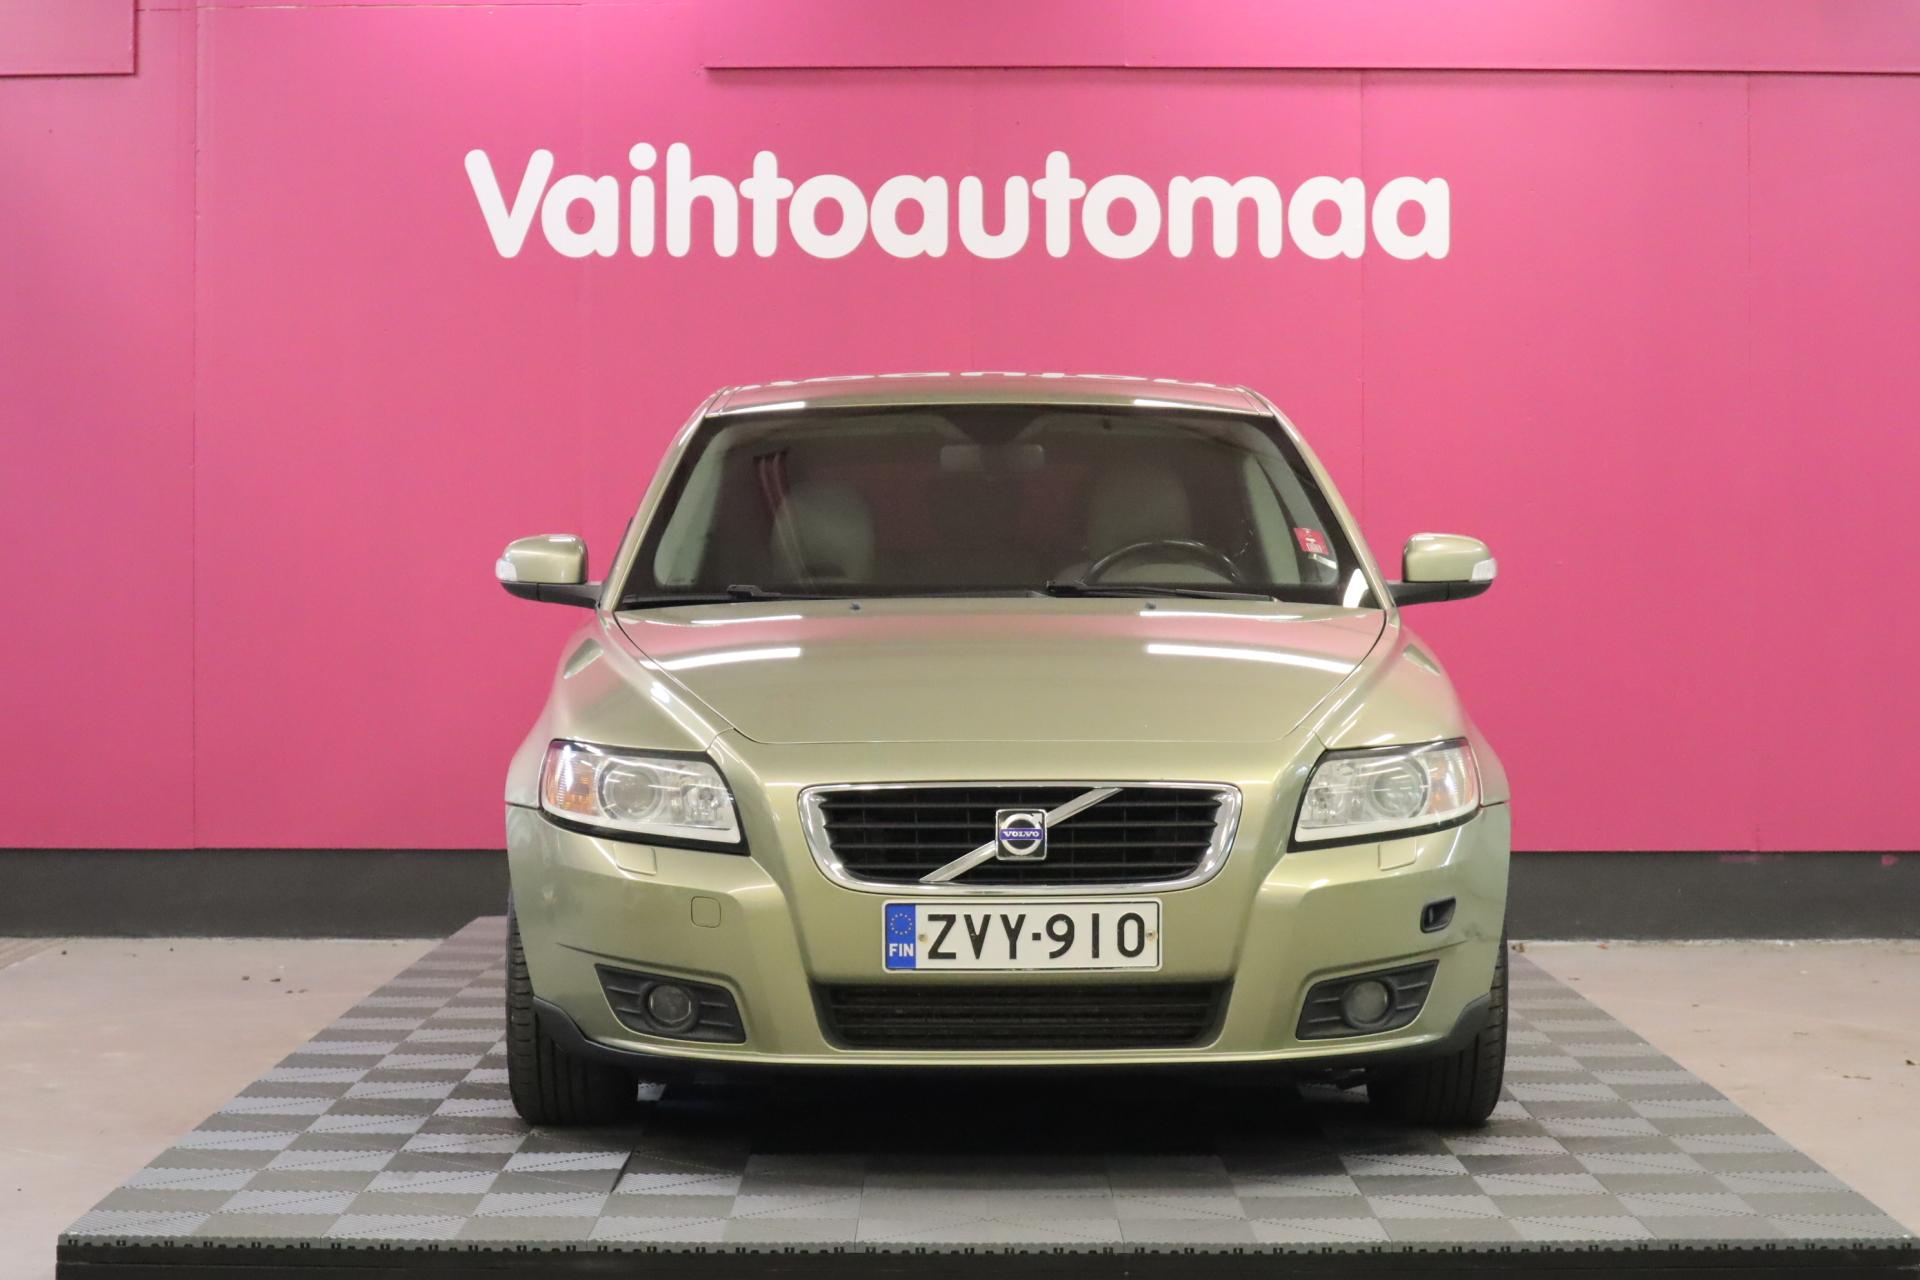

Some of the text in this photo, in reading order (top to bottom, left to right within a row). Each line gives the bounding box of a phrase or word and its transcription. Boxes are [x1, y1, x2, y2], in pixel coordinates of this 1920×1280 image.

[464, 142, 1451, 259] Vaihtoautomaa
[1003, 830, 1040, 838] VOLVO
[888, 943, 915, 957] FIN
[927, 912, 1145, 960] ZVY-910
